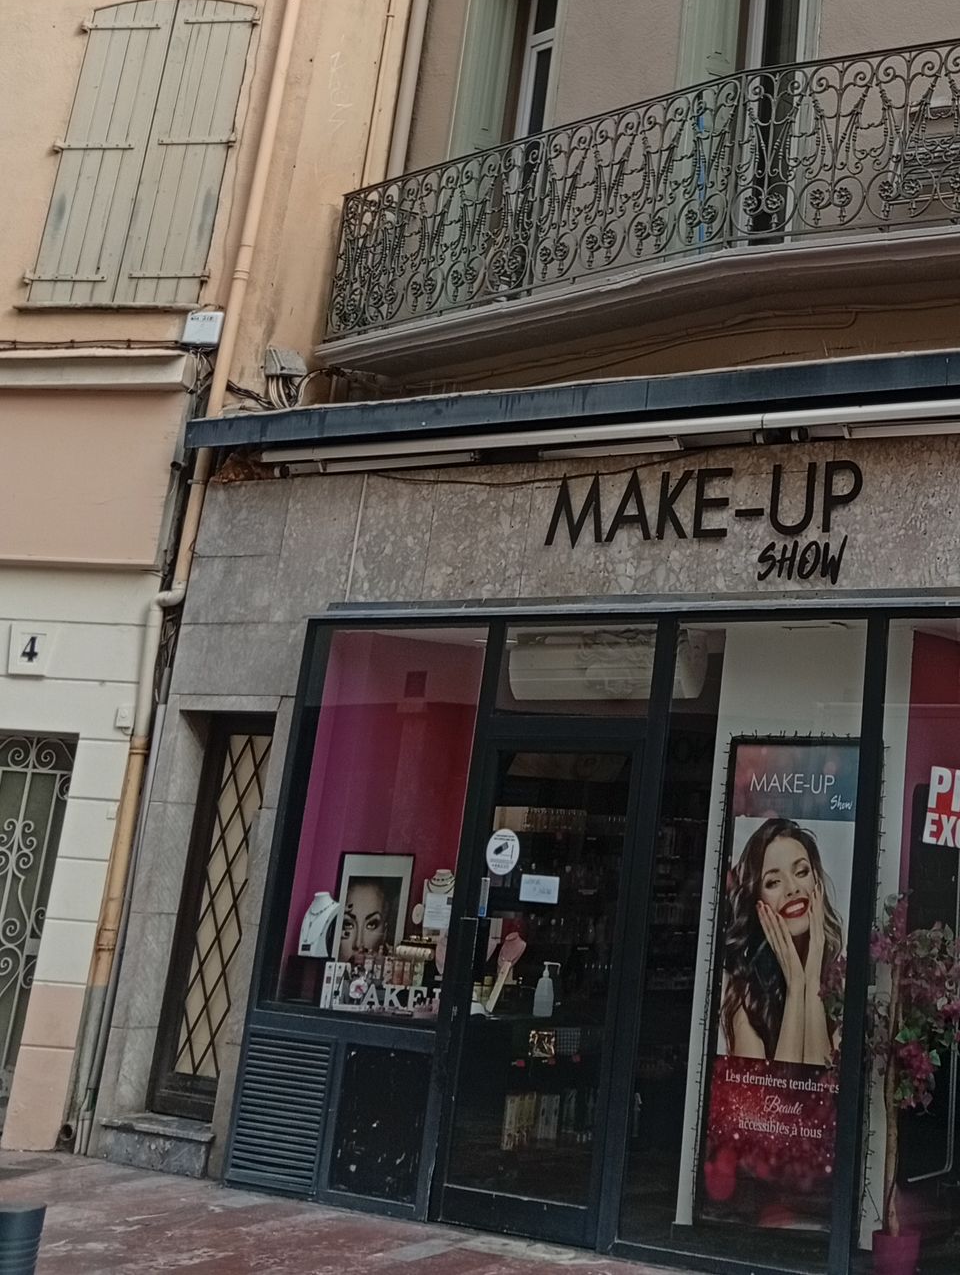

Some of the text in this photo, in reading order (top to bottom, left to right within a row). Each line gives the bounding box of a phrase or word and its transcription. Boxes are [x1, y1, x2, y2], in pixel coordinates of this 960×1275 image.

[544, 460, 863, 550] MAKE-UP
[757, 535, 848, 585] SHOW
[20, 636, 38, 663] 4
[750, 773, 836, 794] MAKE-UP
[830, 794, 853, 811] Show
[725, 1069, 740, 1084] Les
[742, 1071, 787, 1089] dernières
[738, 1117, 789, 1135] accessibles
[800, 1126, 822, 1139] tous
